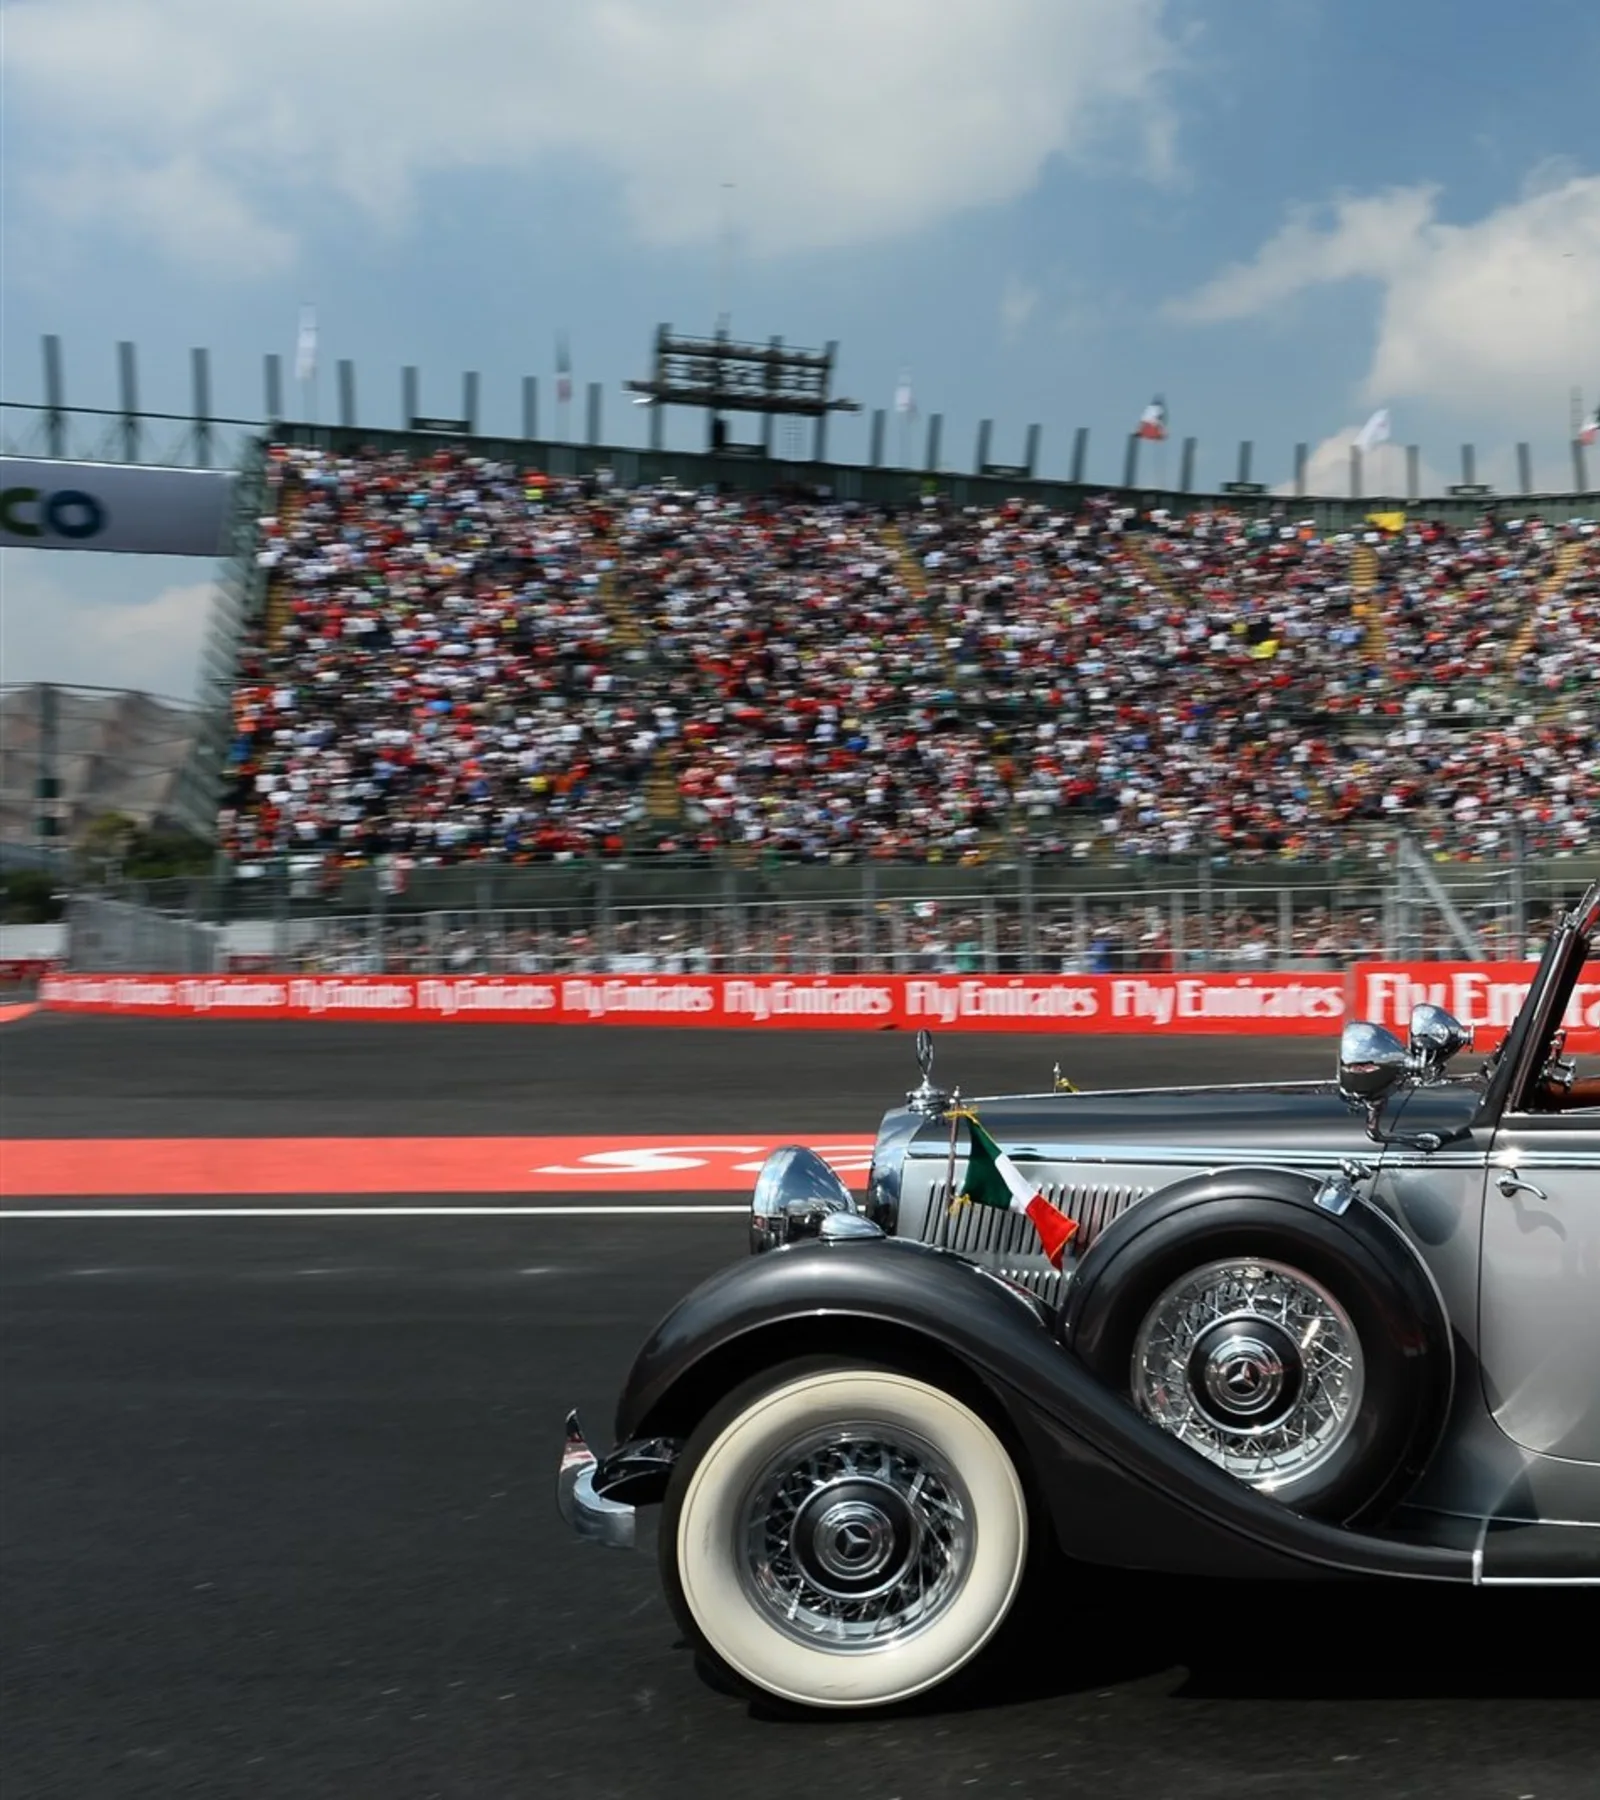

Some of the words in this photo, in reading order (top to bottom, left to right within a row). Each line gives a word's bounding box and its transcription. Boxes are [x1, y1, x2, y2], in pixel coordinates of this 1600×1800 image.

[562, 980, 606, 1018] Fly
[603, 978, 713, 1012] Emirates
[723, 981, 772, 1021] Fly
[770, 979, 891, 1014] Emirates
[905, 980, 959, 1023] Fly
[957, 979, 1098, 1016] Emirates
[1111, 980, 1175, 1024] Fly
[1175, 977, 1345, 1018] Emirates
